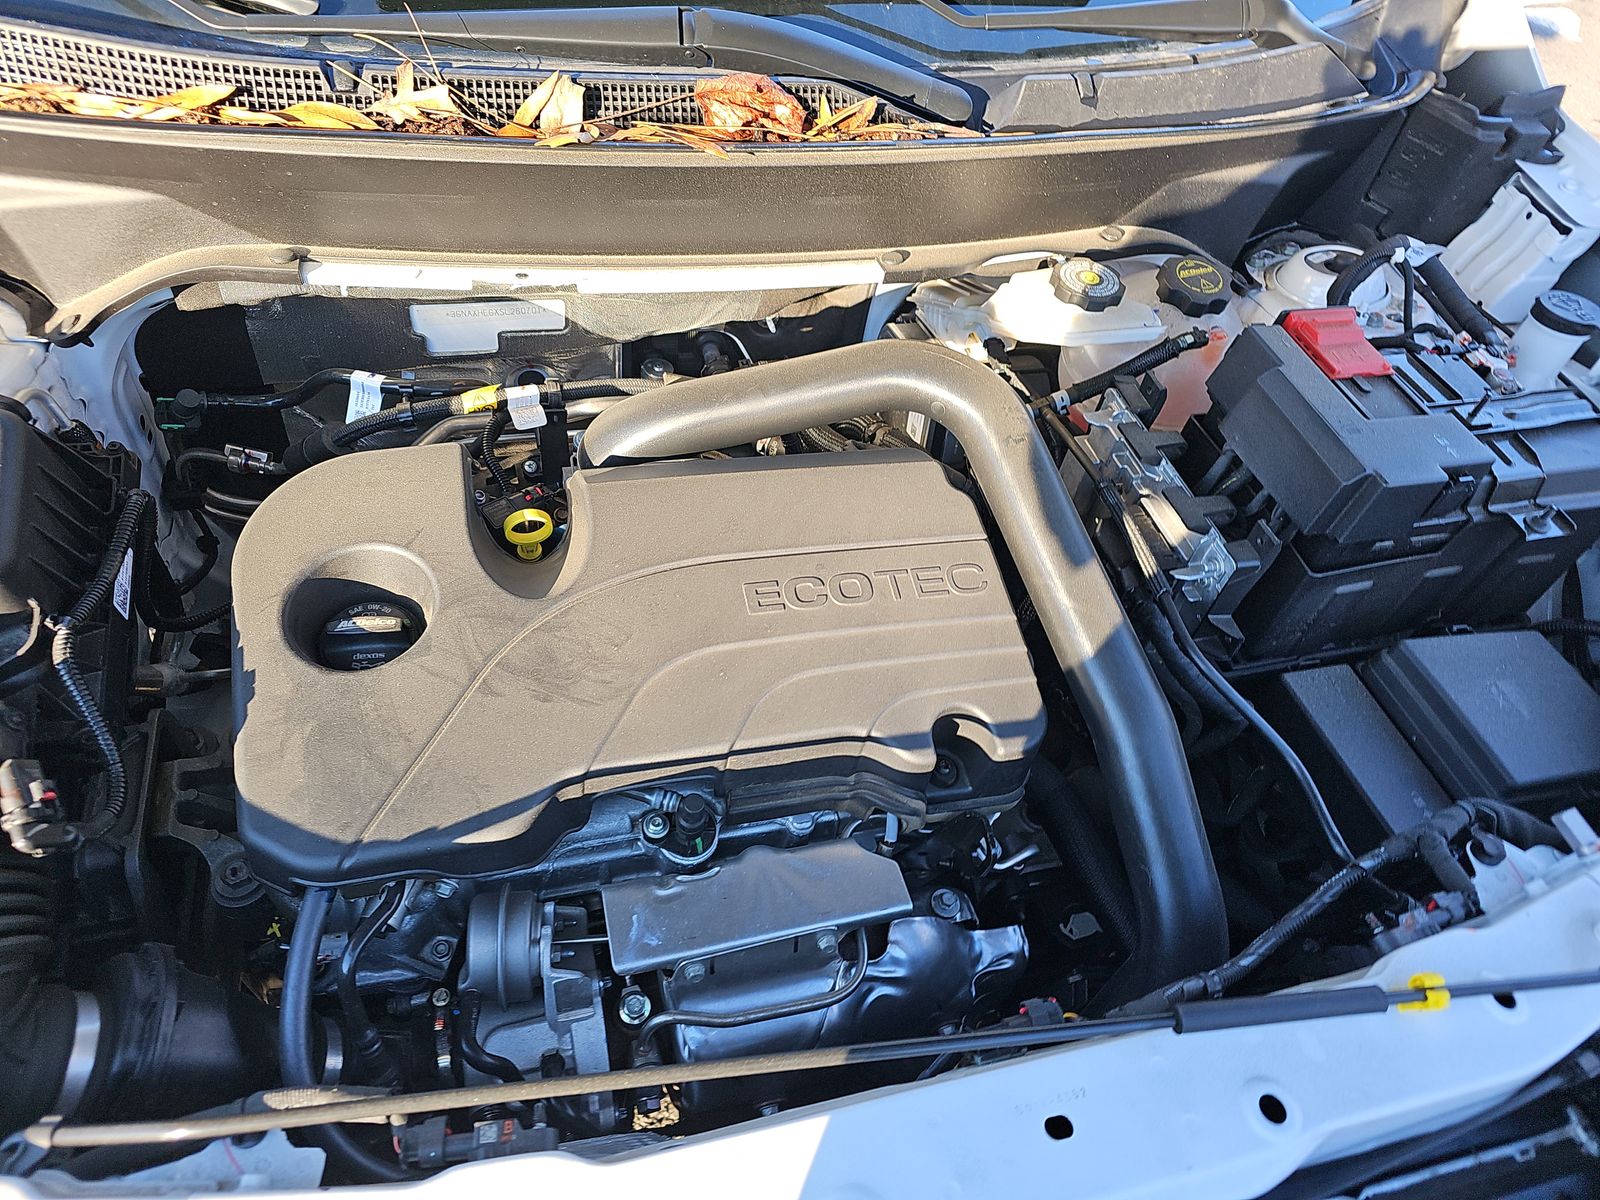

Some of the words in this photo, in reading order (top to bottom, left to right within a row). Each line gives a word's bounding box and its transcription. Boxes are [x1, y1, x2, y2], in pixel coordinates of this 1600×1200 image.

[742, 562, 989, 616] ECOTEC
[348, 605, 364, 616] SAE
[367, 603, 392, 614] 0W-20
[352, 652, 386, 660] dexos
